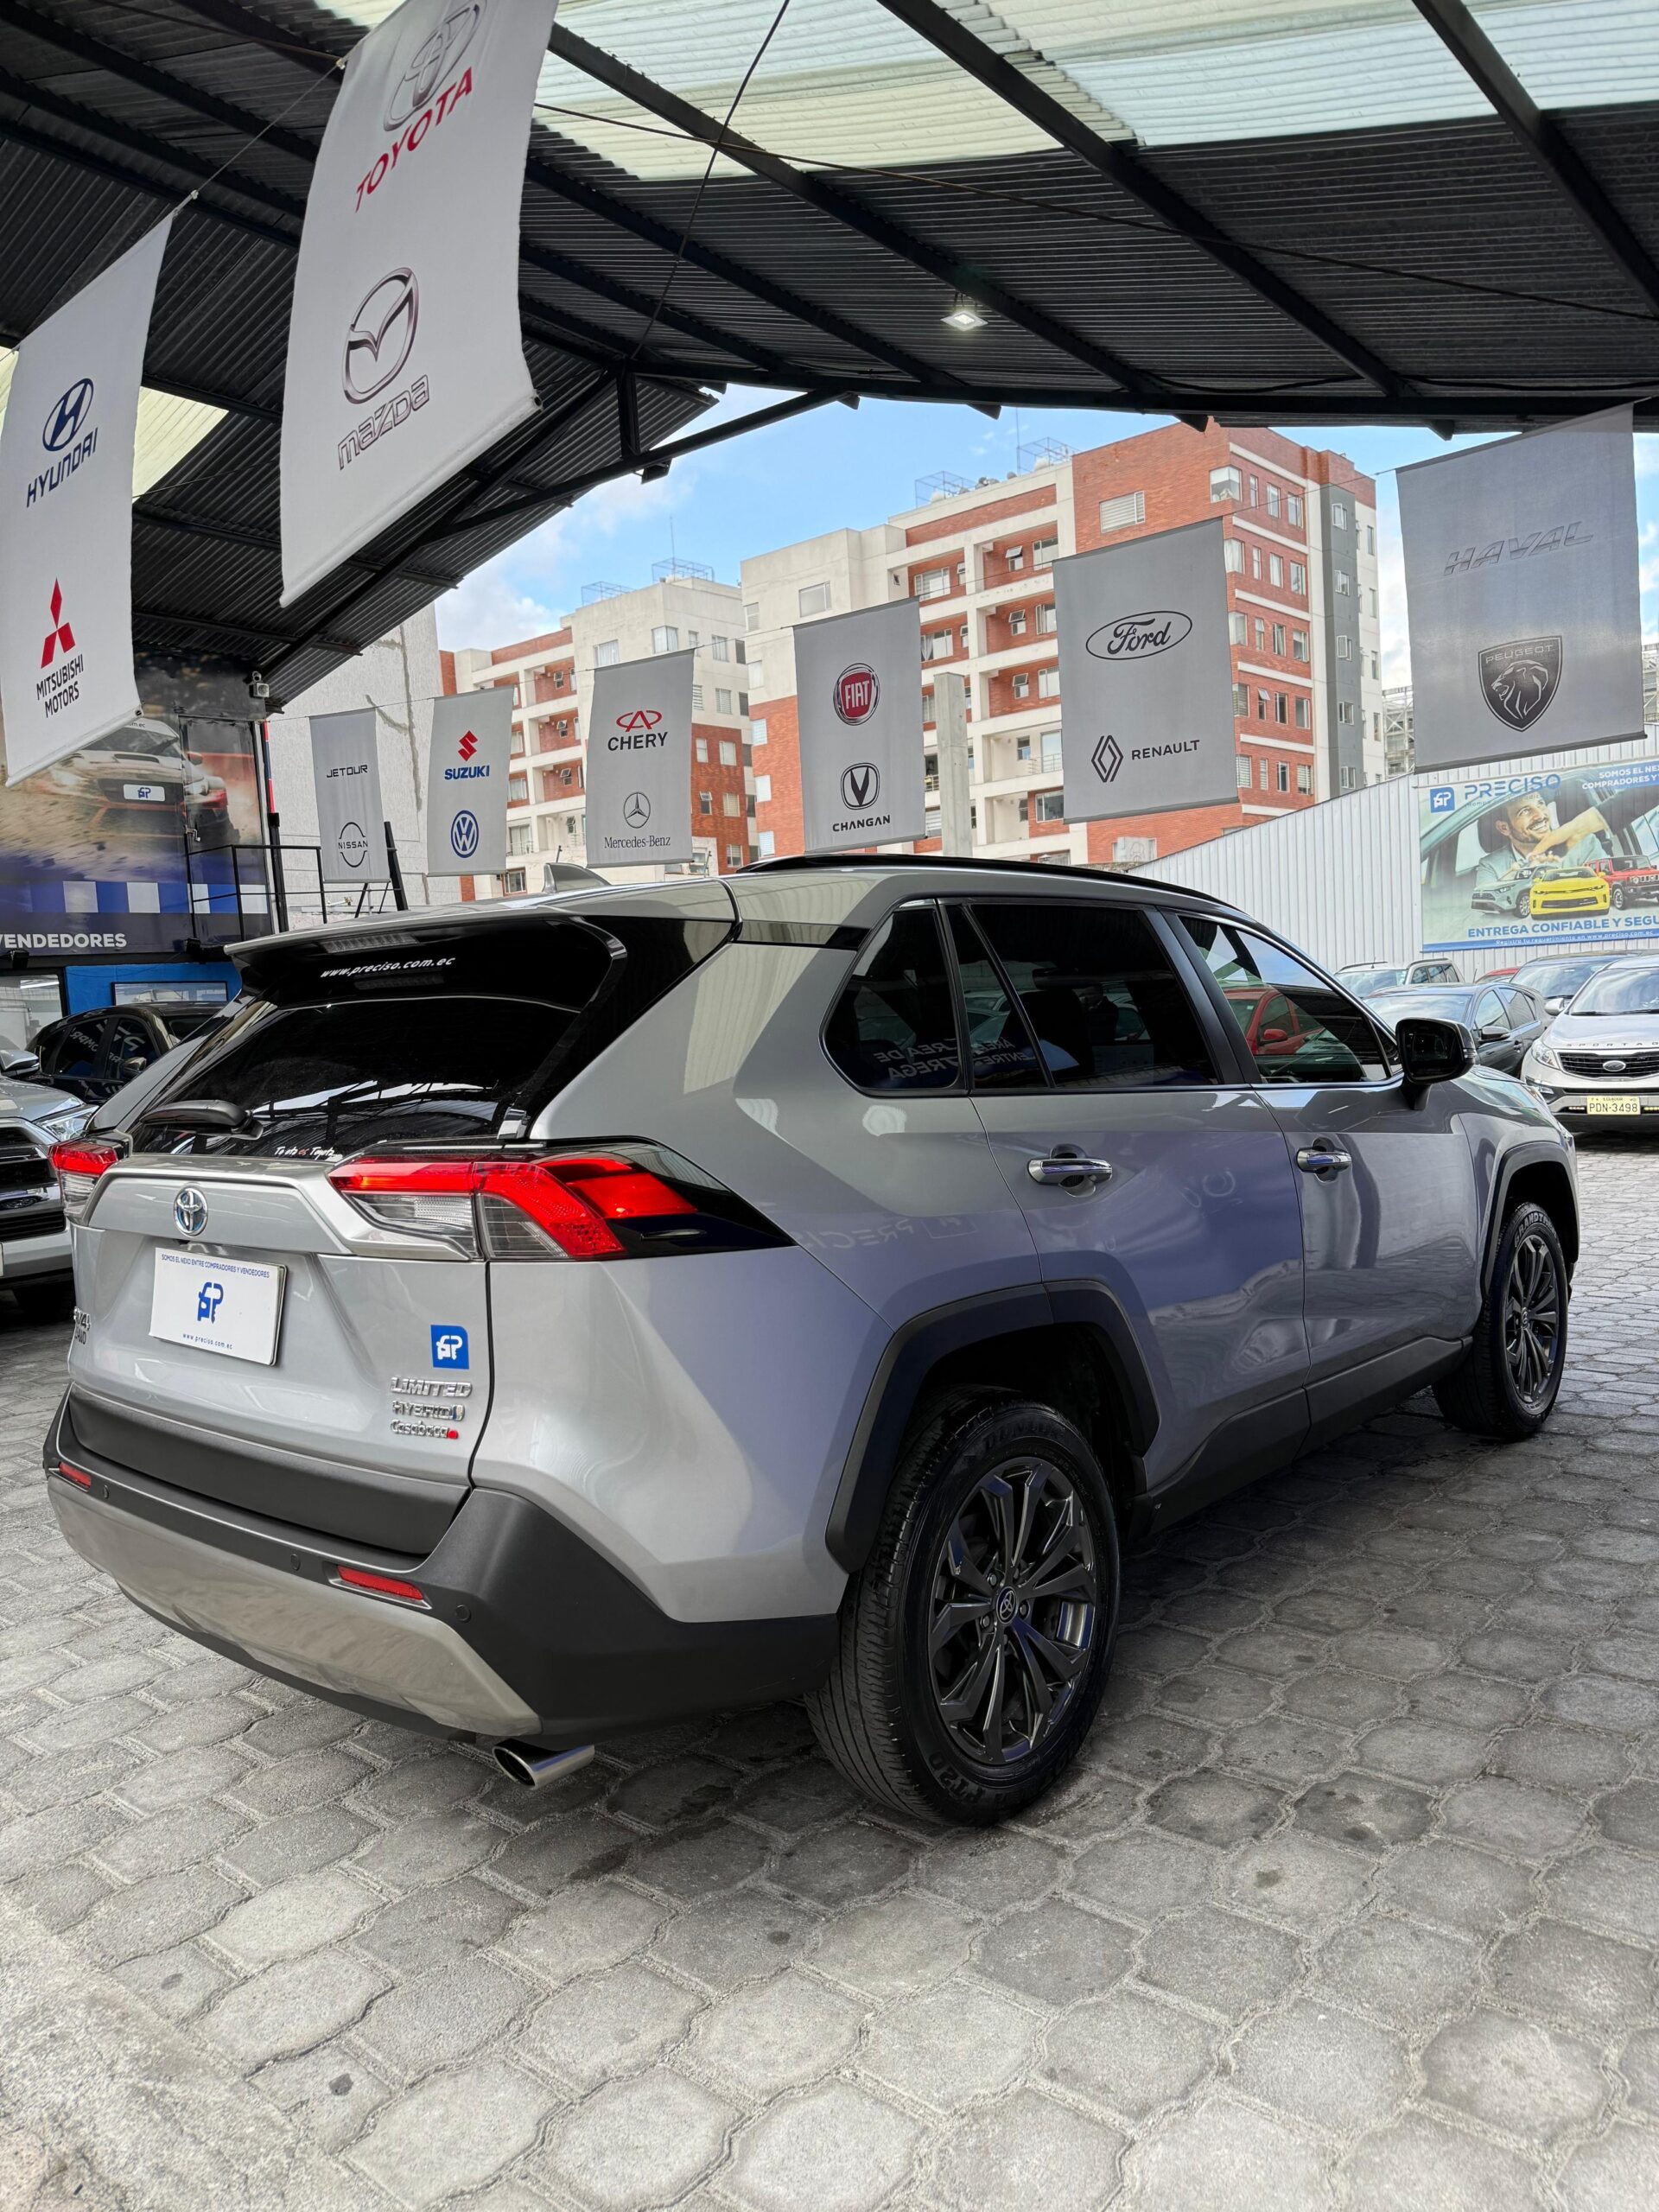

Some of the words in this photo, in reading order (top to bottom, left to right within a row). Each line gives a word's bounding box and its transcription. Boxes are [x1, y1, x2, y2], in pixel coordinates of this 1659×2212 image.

[355, 66, 473, 213] TOYOTA
[26, 428, 99, 507] HYUNDAI
[1444, 521, 1593, 575] HAVAL
[1107, 618, 1172, 654] Ford
[1485, 645, 1554, 664] PEUGEOT
[36, 653, 84, 701] MITSUBISHI
[45, 681, 79, 718] MOTORS
[845, 680, 870, 709] FIAT
[607, 731, 669, 751] CHERY
[1131, 740, 1200, 760] RENAULT
[327, 765, 368, 778] JETOUR
[444, 765, 490, 780] SUZUKI
[1599, 768, 1631, 779] SOMOS
[1465, 773, 1560, 799] PRECISO
[1582, 775, 1649, 790] COMPRADORES
[832, 815, 891, 832] CHANGAN
[338, 840, 368, 849] NISSAN
[604, 835, 671, 849] Mercedes-Benz
[1468, 925, 1529, 938] ENTREGA
[1531, 918, 1611, 933] CONFIABLE
[1612, 918, 1622, 927] Y
[320, 957, 456, 977] www.preciso.com.ec
[1589, 1103, 1638, 1113] PDN-3498
[161, 1254, 175, 1262] SOMOS
[192, 1259, 205, 1268] ENTRE
[205, 1261, 236, 1273] COMPRADORES
[240, 1267, 270, 1278] VENDEDORES
[182, 1332, 233, 1350] www.preciso.com.ec
[391, 1376, 473, 1397] LIMITED
[392, 1400, 453, 1420] HYBRID
